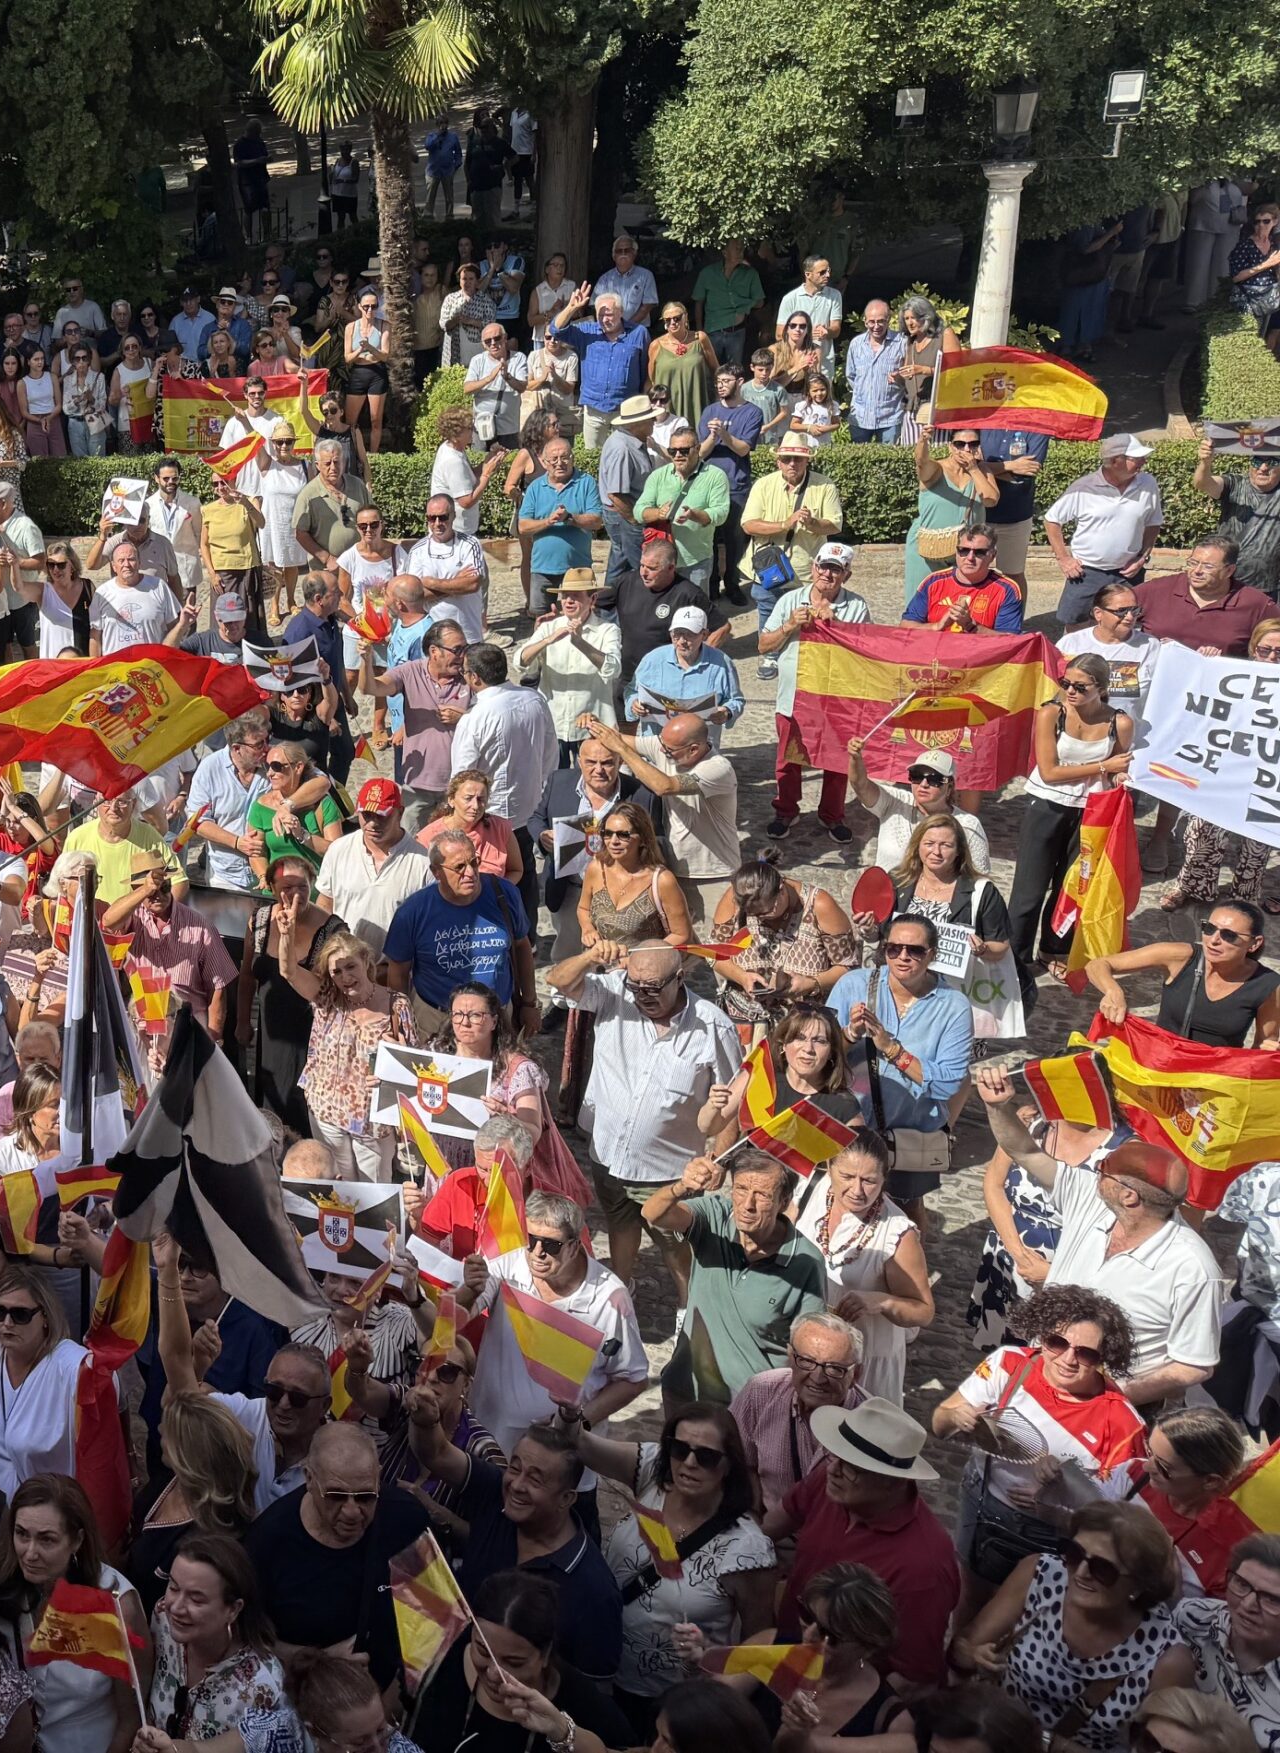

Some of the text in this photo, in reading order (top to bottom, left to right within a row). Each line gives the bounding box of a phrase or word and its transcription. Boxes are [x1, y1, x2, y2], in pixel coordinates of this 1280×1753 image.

[1185, 692, 1280, 731] NO S
[1175, 744, 1280, 793] SE D
[938, 938, 963, 955] CEUTA
[960, 976, 1007, 1004] VOX
